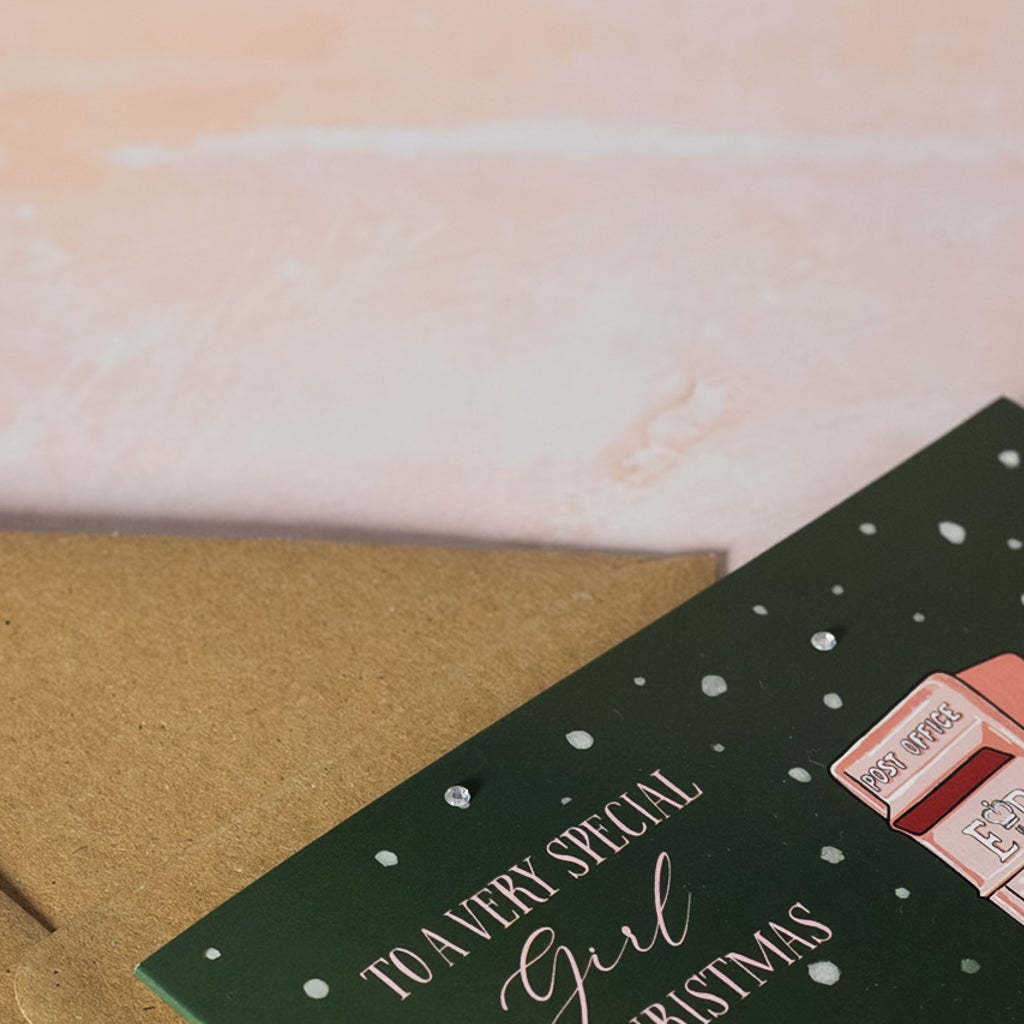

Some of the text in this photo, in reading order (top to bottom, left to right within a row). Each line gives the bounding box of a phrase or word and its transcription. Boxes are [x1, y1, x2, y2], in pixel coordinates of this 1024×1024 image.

[860, 701, 963, 792] POST OFFICE
[360, 769, 704, 1001] TO A VERY SPECIAL
